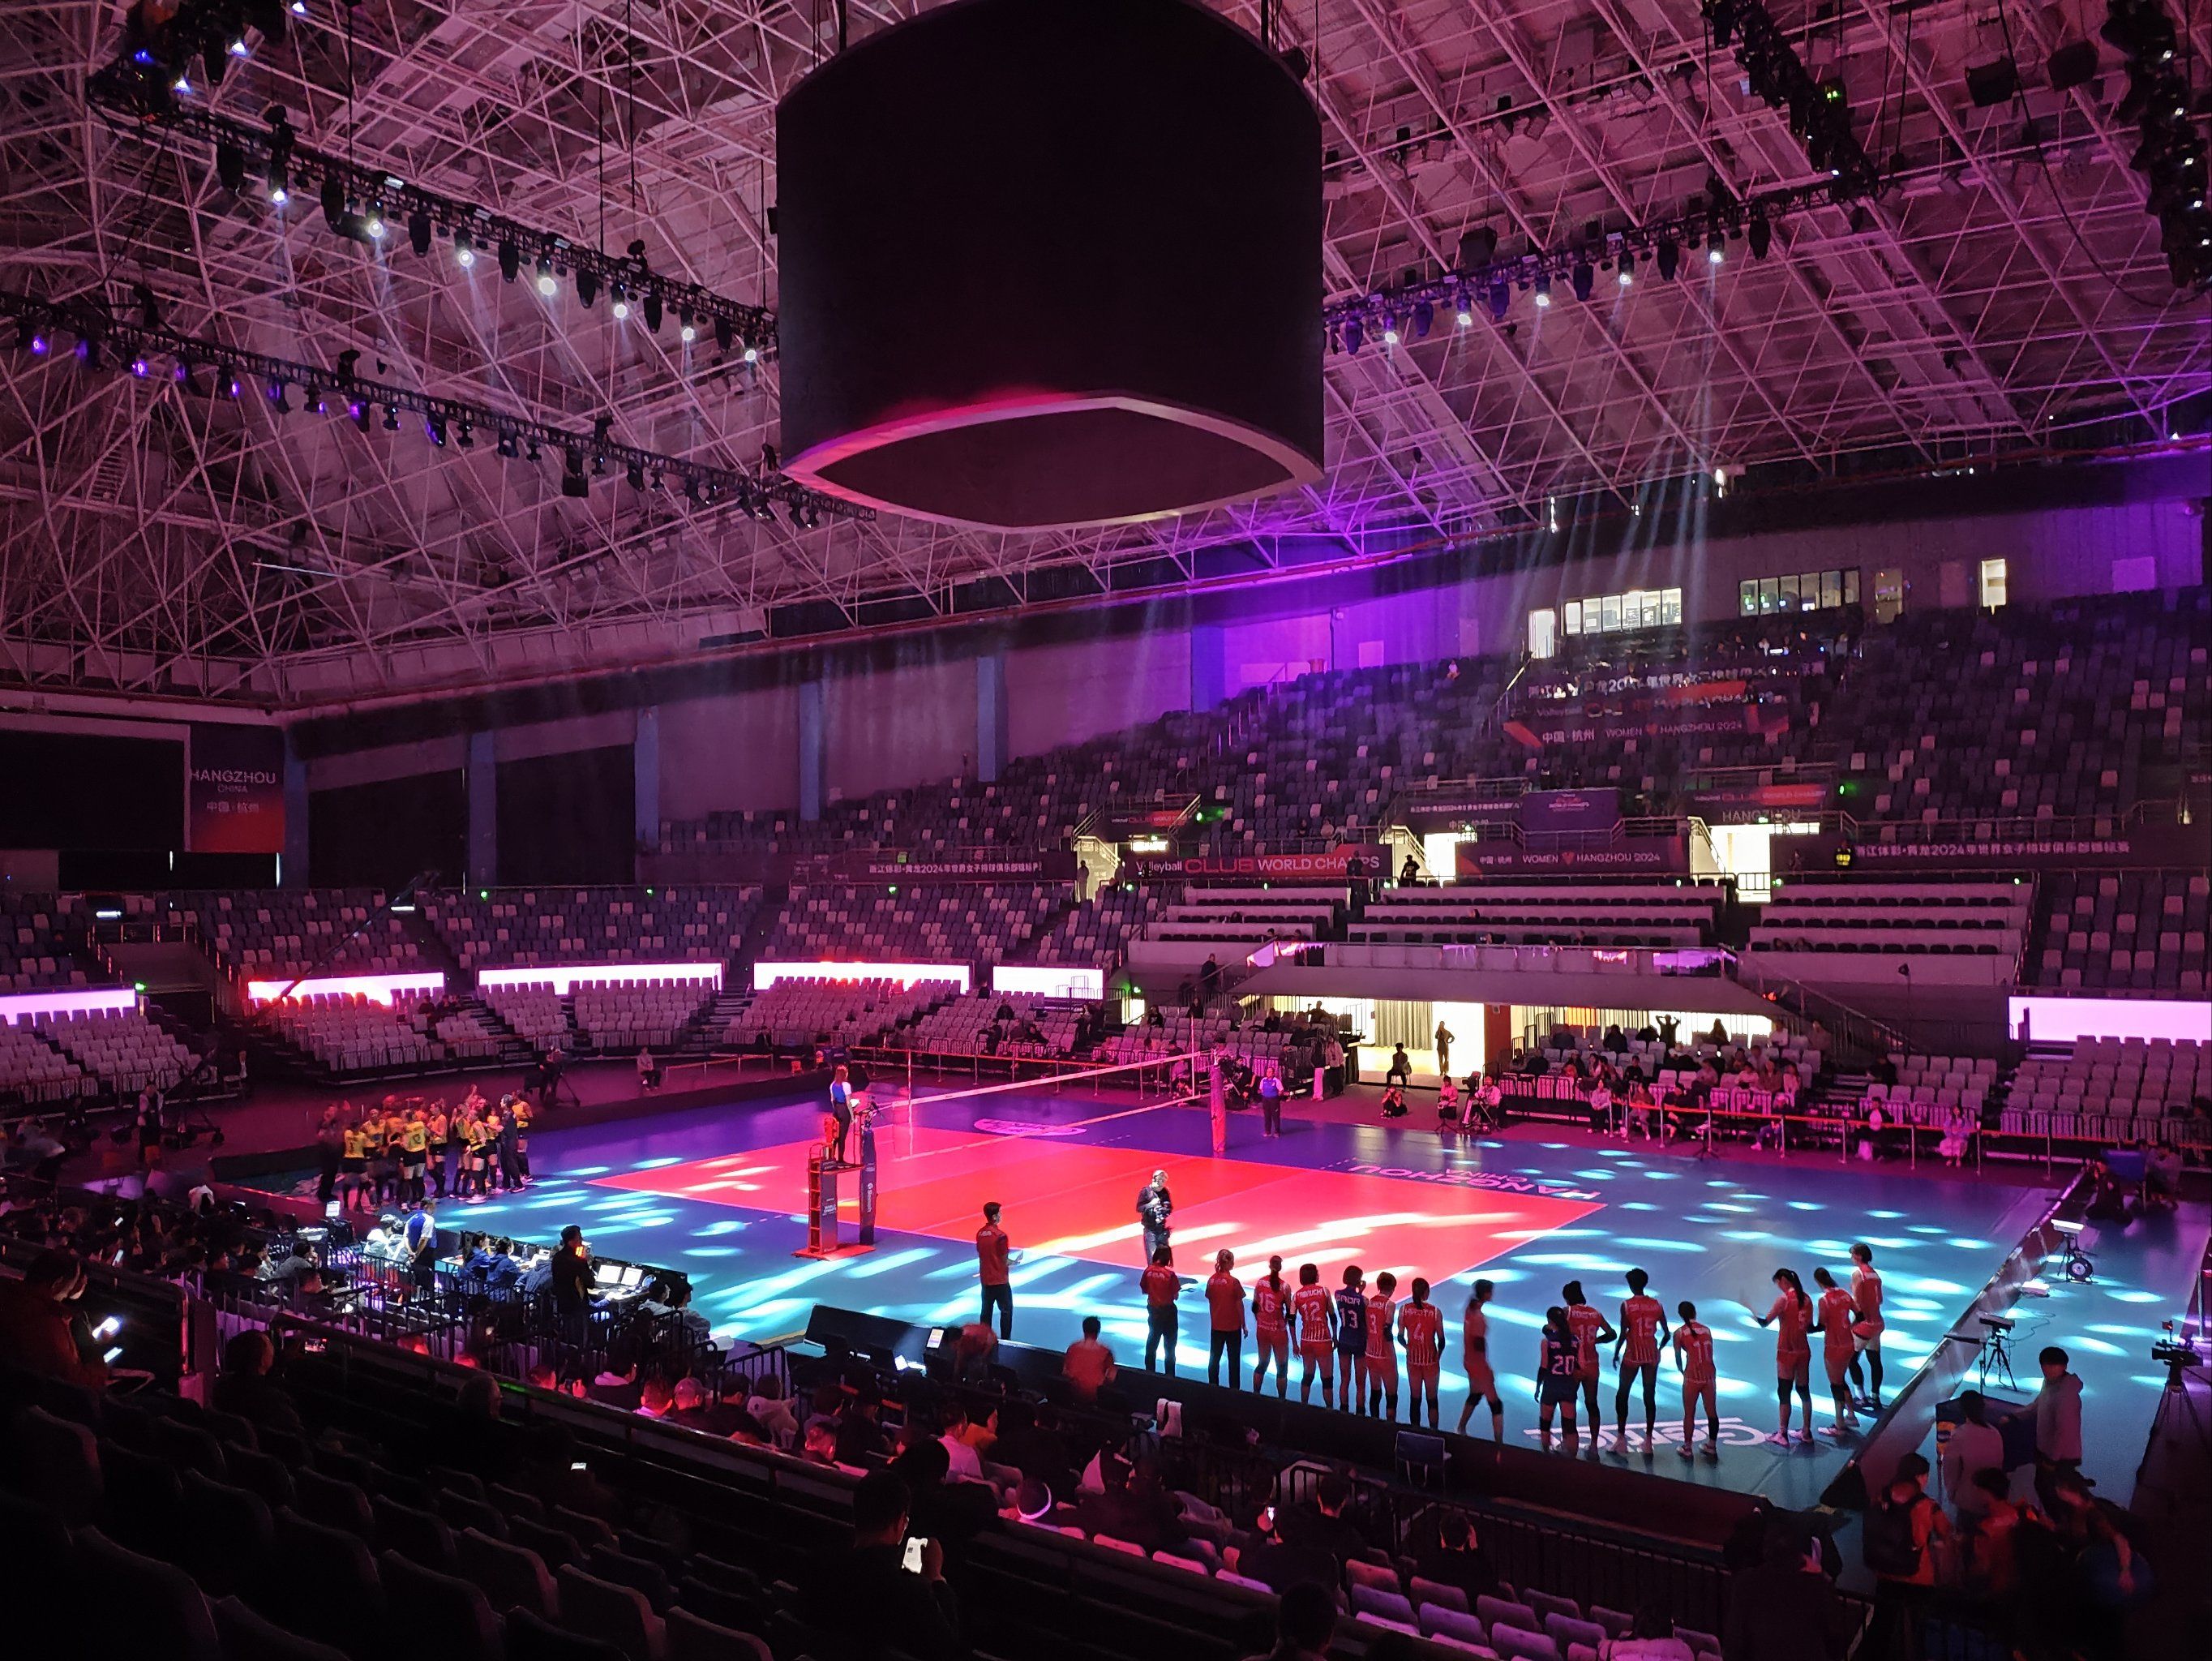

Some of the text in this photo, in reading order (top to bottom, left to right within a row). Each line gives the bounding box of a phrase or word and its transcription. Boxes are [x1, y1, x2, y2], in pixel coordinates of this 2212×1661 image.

[191, 769, 276, 784] HANGZHOU
[1136, 856, 1380, 874] Vlleyball CLUB WORLD CHAPS
[1523, 852, 1661, 864] WOMEN HANGZHOU 2024
[1348, 1165, 1601, 1200] HANGZHOU
[1446, 1168, 1528, 1183] CHINA
[1258, 1291, 1275, 1313] 16
[1301, 1300, 1322, 1321] 12
[1340, 1307, 1358, 1328] 13
[1551, 1354, 1575, 1376] 20
